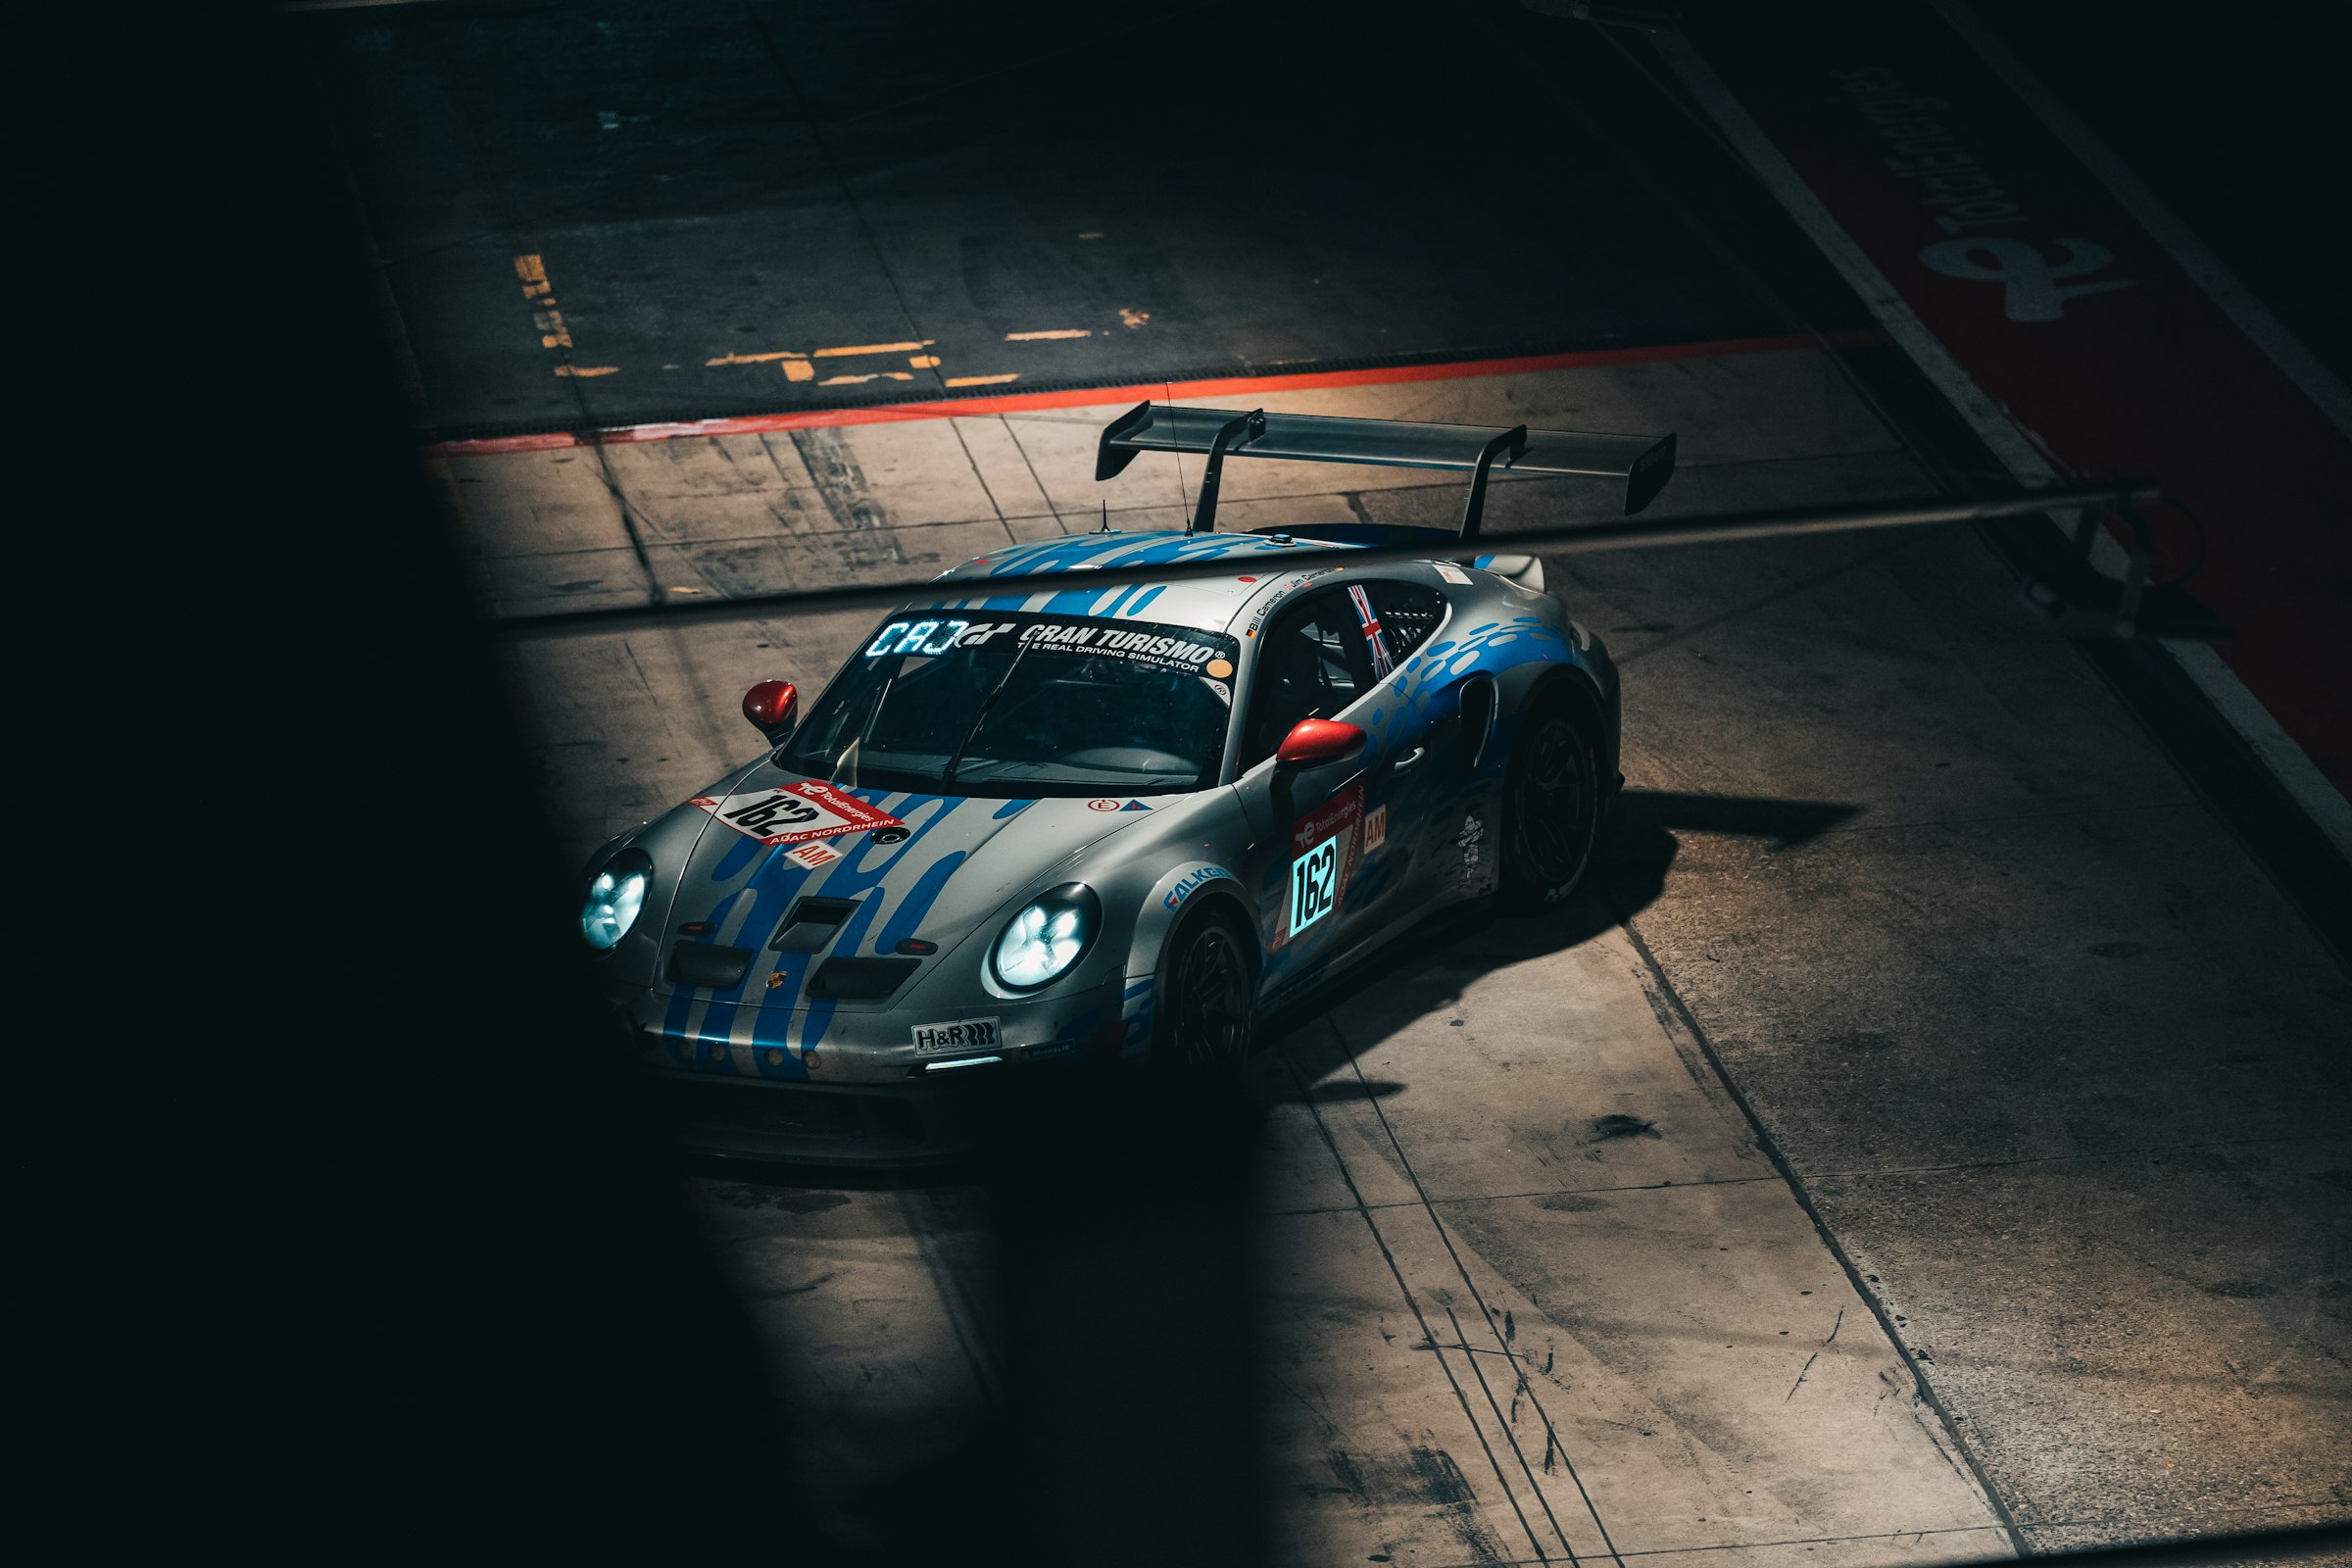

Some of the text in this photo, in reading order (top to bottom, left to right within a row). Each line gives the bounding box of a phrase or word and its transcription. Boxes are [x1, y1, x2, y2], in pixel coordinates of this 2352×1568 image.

[1249, 590, 1286, 631] Bill Cameron
[1019, 623, 1096, 645] GRAN
[1042, 643, 1073, 652] REAL
[1075, 646, 1126, 658] DRIVING
[1127, 652, 1200, 673] SIMULATOR
[723, 794, 820, 837] 162
[821, 792, 875, 823] TotalEnergies
[1314, 800, 1357, 834] TotalEnergies
[770, 818, 895, 845] ADAC NORDRHEIN
[1348, 784, 1365, 868] NORDRHEIN
[1365, 811, 1386, 849] AM
[792, 845, 836, 866] AM
[1295, 843, 1335, 929] 162
[917, 1025, 966, 1049] H&R
